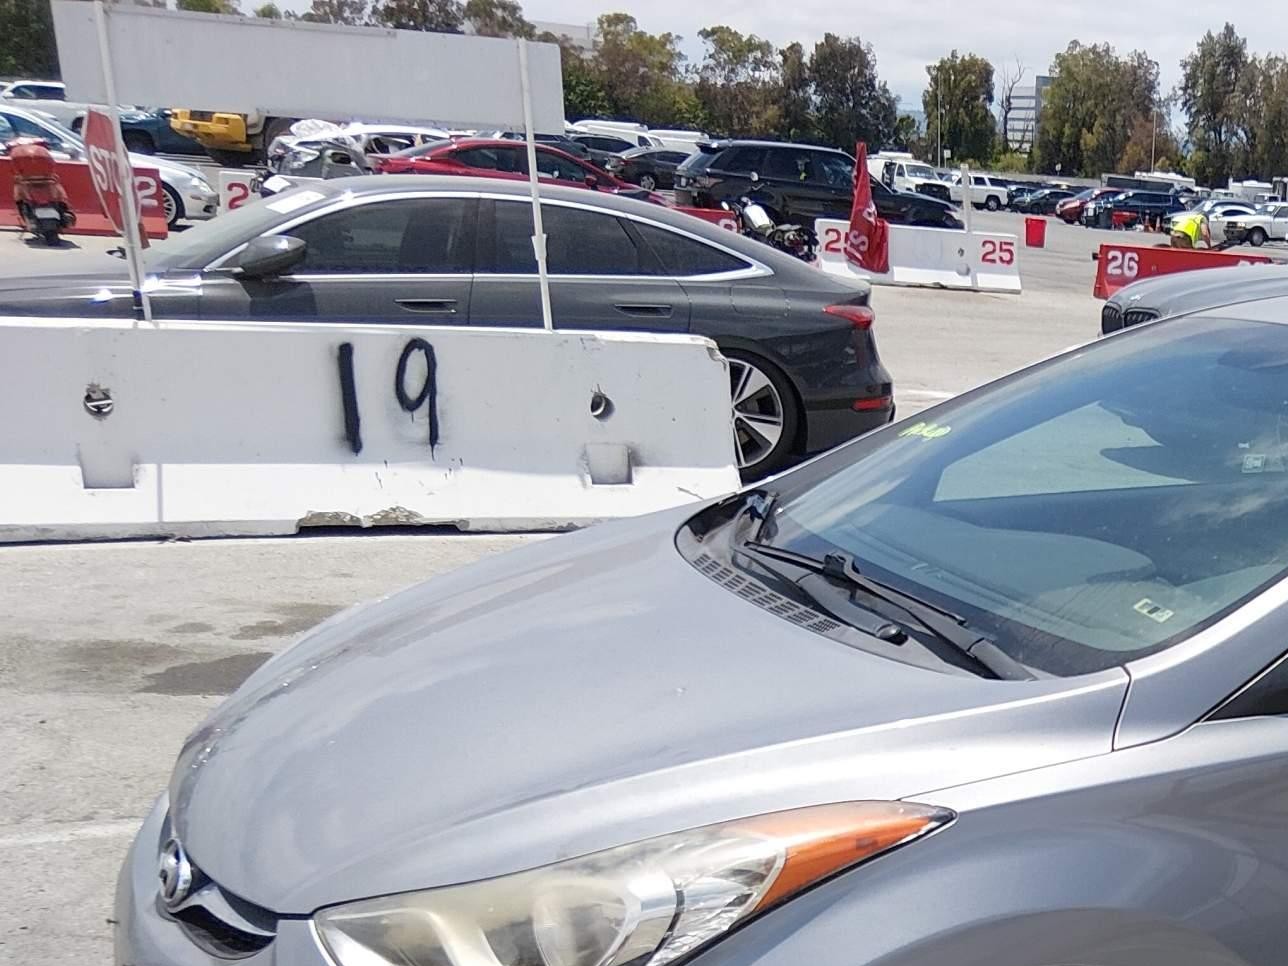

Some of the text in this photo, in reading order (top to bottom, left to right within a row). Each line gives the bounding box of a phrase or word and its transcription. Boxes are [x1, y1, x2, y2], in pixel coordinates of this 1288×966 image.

[89, 144, 132, 197] STO
[980, 240, 1015, 265] 25
[1106, 250, 1139, 278] 26
[337, 337, 440, 459] 19
